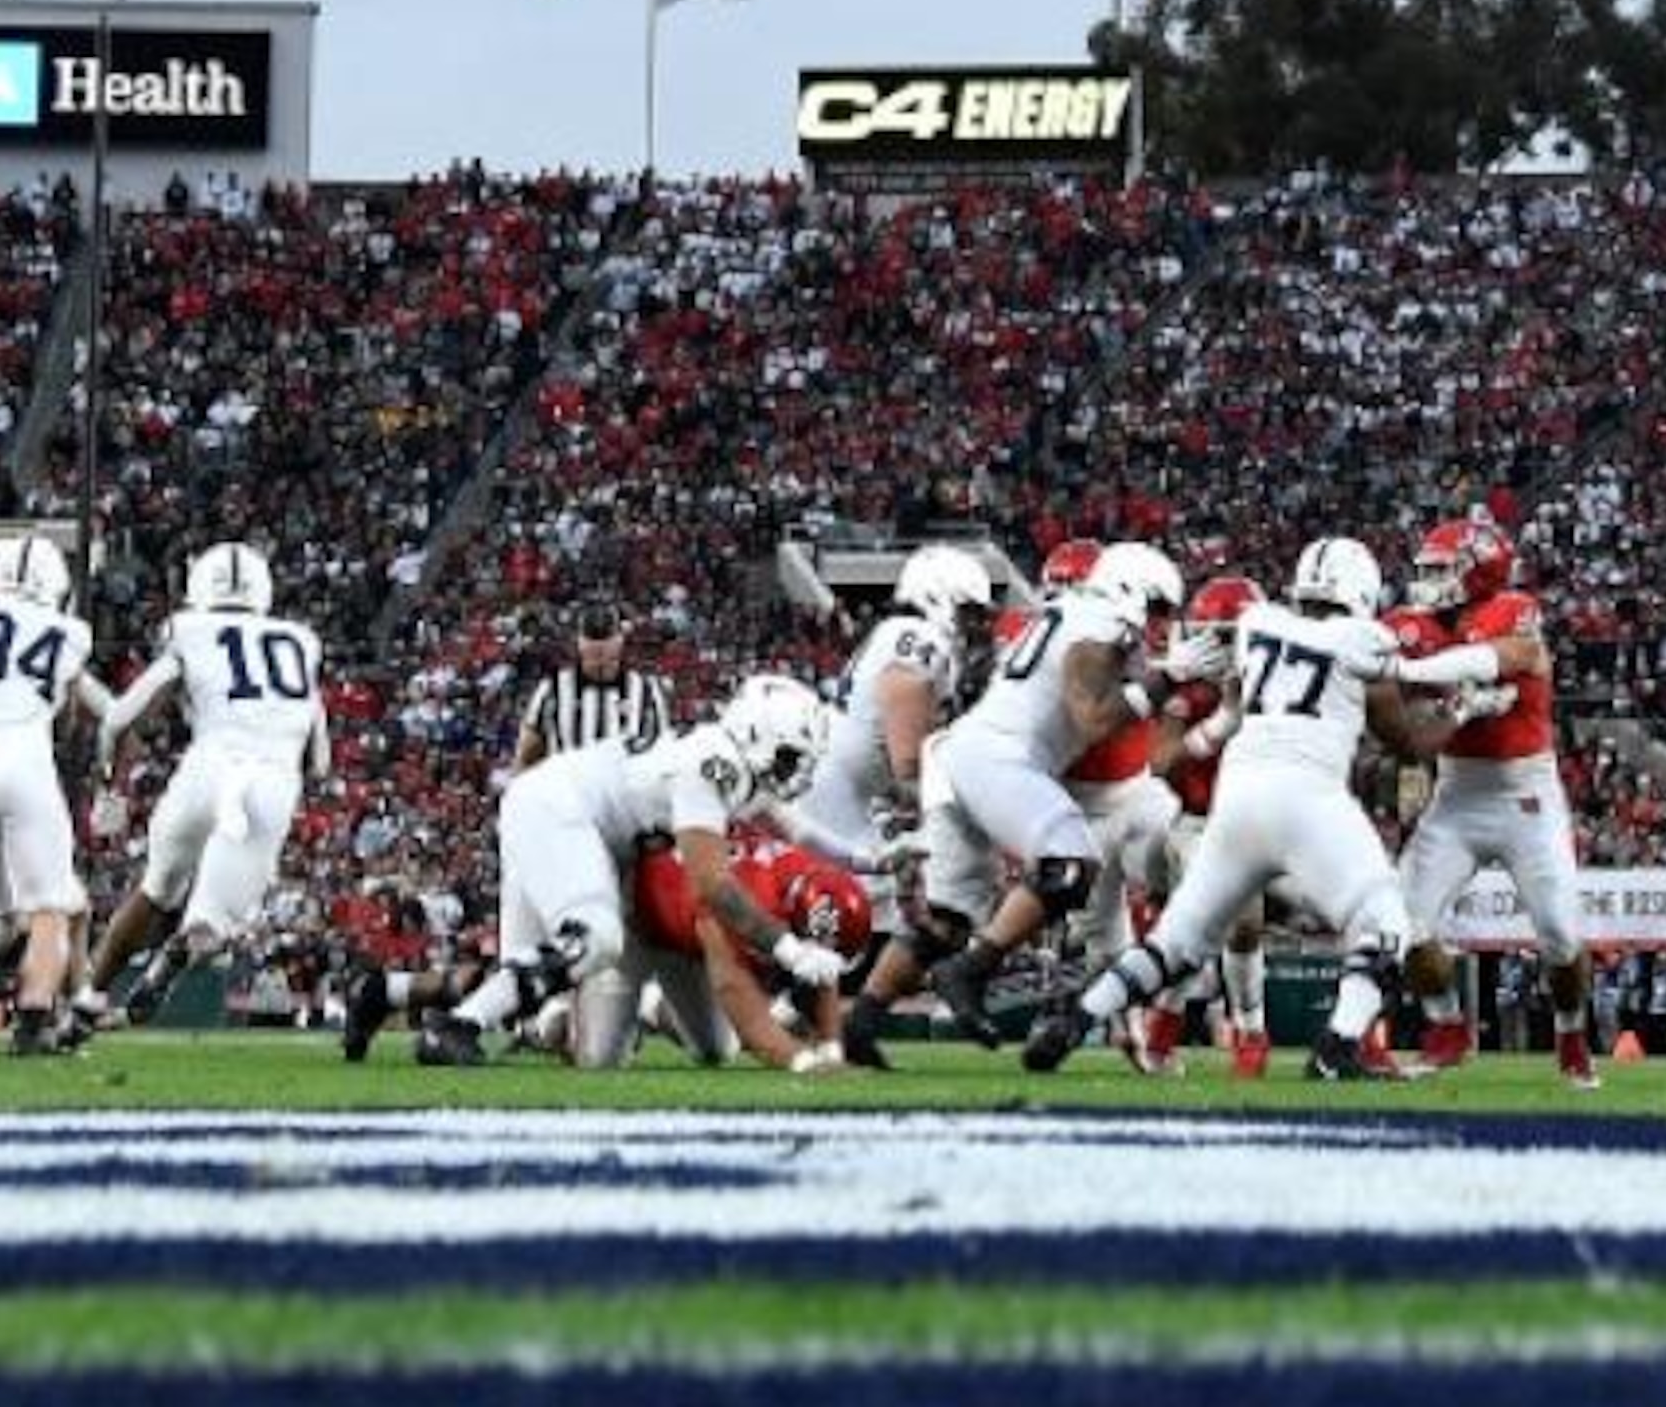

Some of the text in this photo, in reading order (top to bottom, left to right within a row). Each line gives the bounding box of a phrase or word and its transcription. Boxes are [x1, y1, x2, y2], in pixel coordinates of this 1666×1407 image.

[51, 56, 245, 116] Health
[798, 76, 1131, 140] C4 ENERGY
[216, 624, 312, 700] 10
[1245, 632, 1336, 719] 77
